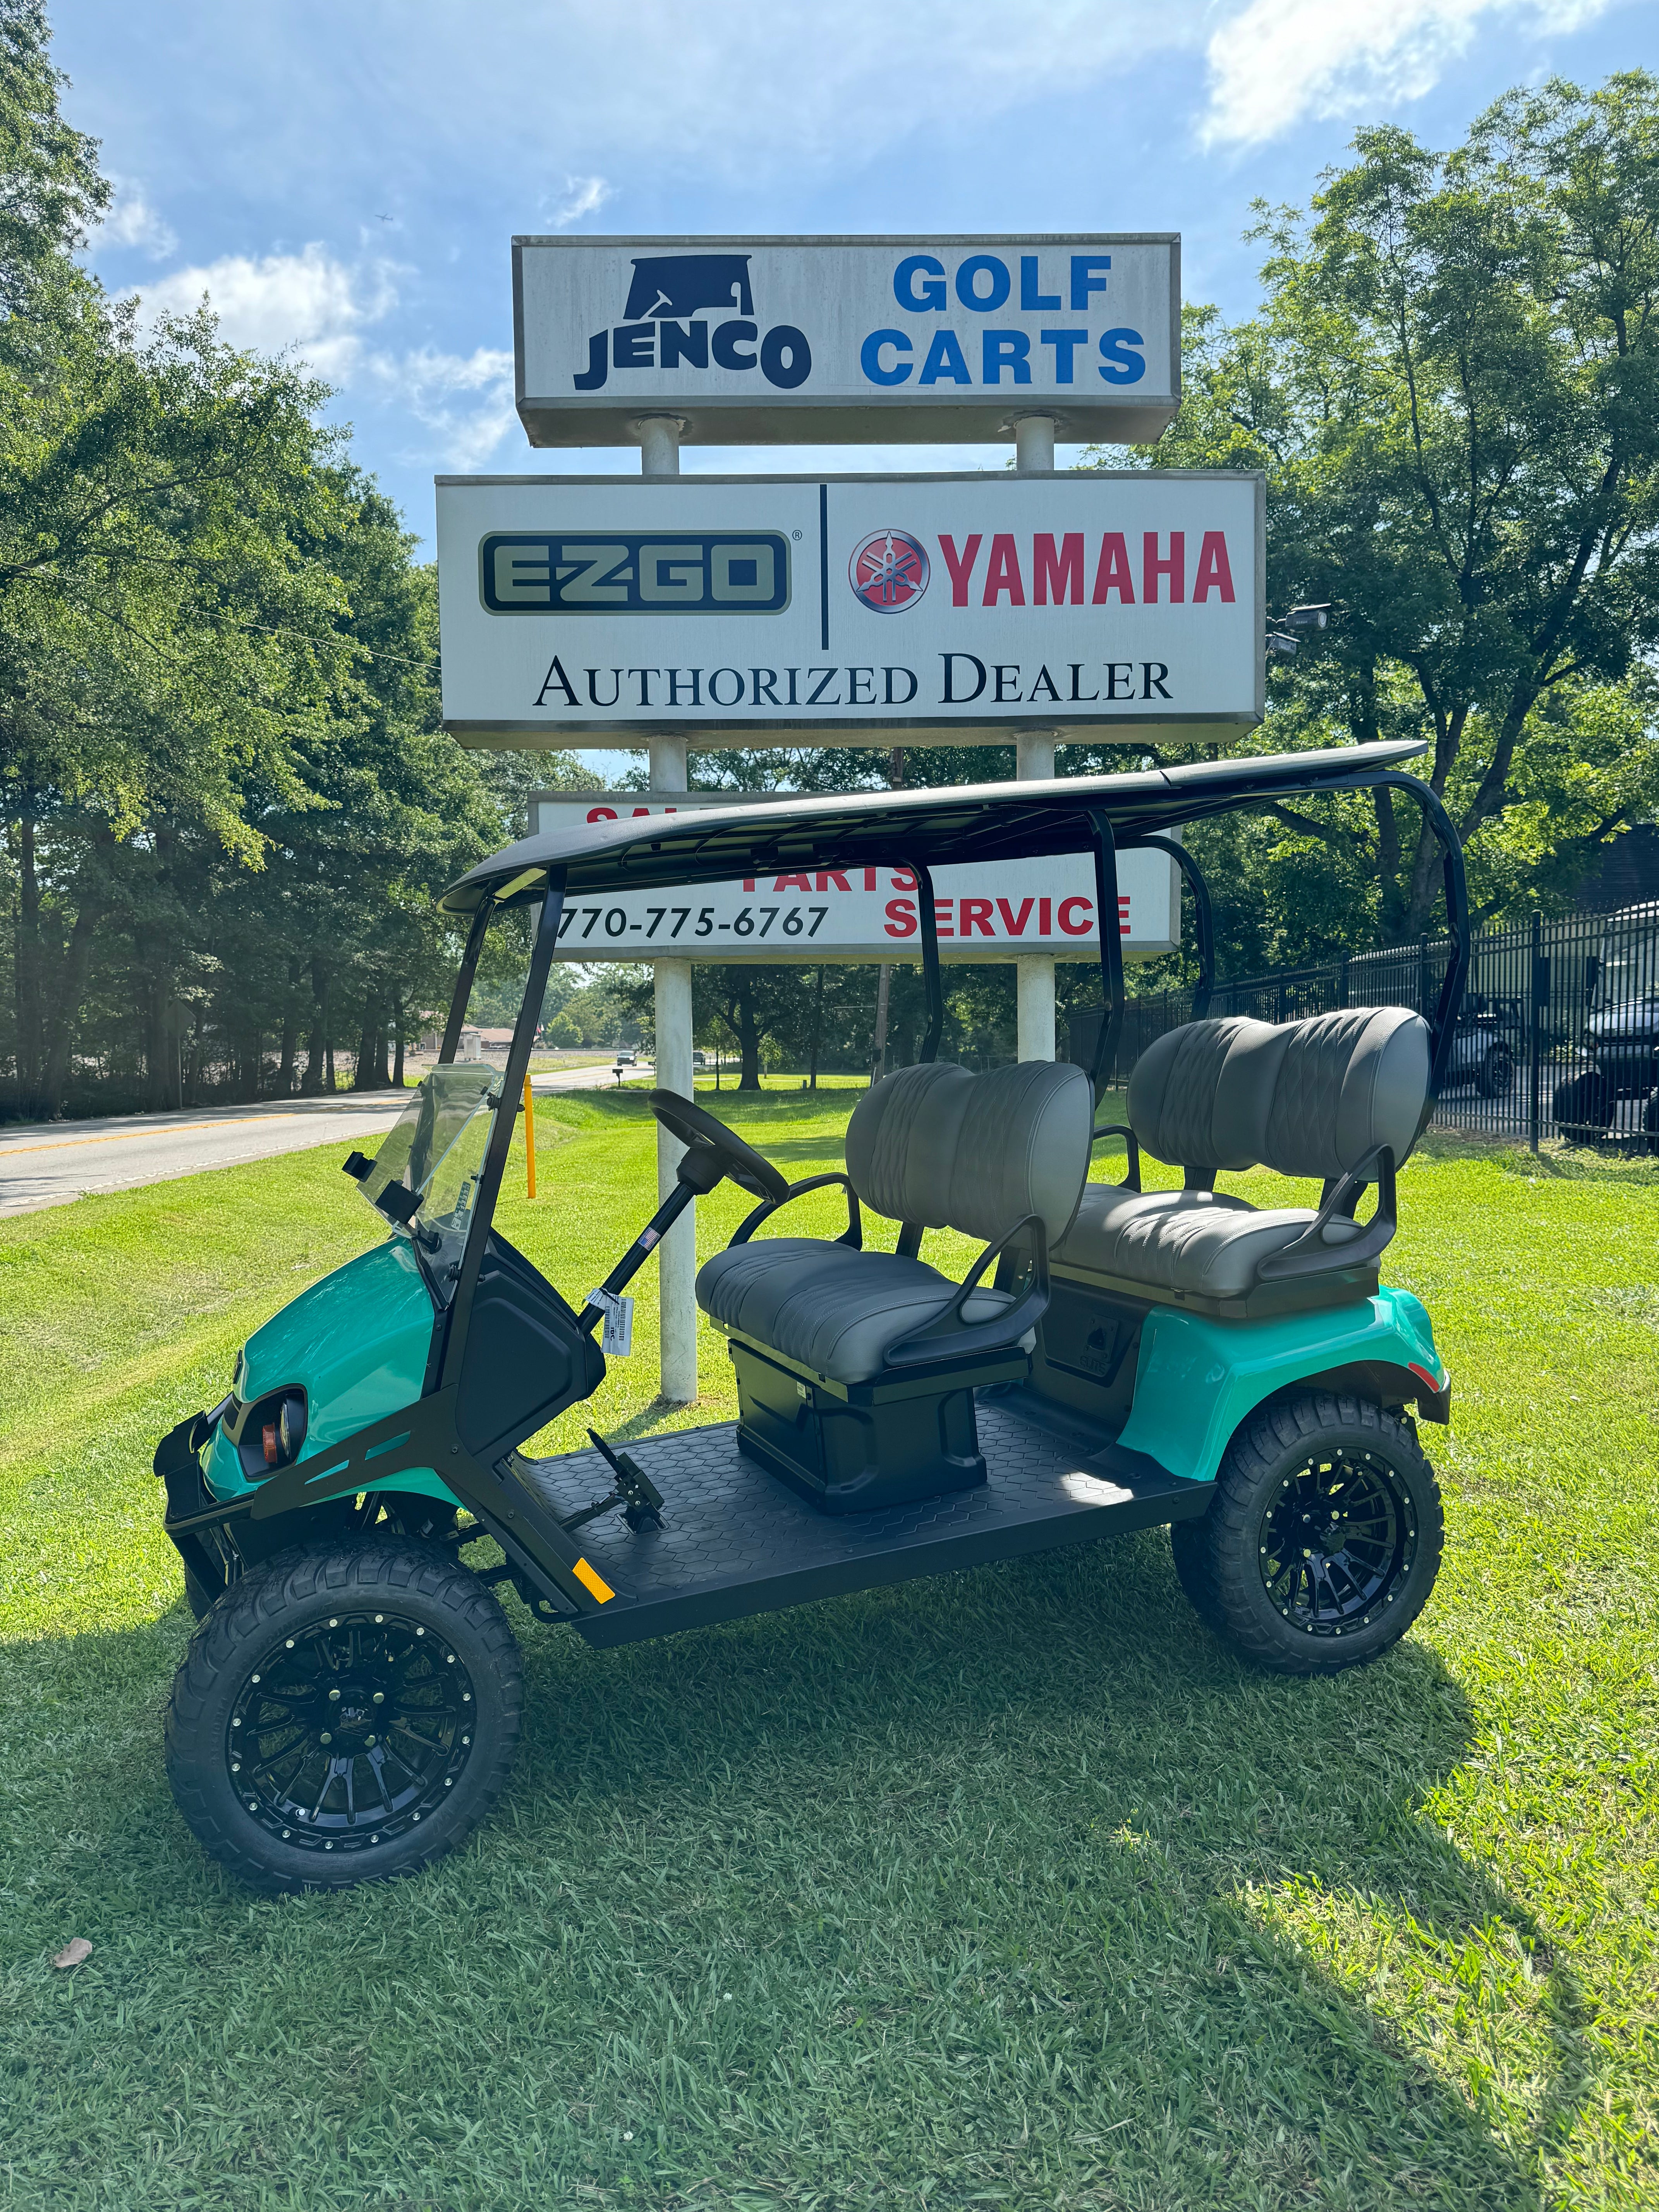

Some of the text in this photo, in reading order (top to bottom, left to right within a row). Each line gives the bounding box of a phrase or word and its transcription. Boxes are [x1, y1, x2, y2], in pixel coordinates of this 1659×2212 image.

[893, 255, 1111, 313] GOLF
[574, 320, 812, 390] JENCO
[860, 328, 1146, 386] CARTS
[938, 531, 1236, 607] YAMAHA
[938, 653, 1173, 703] DEALER
[557, 907, 829, 939] 770-775-6767
